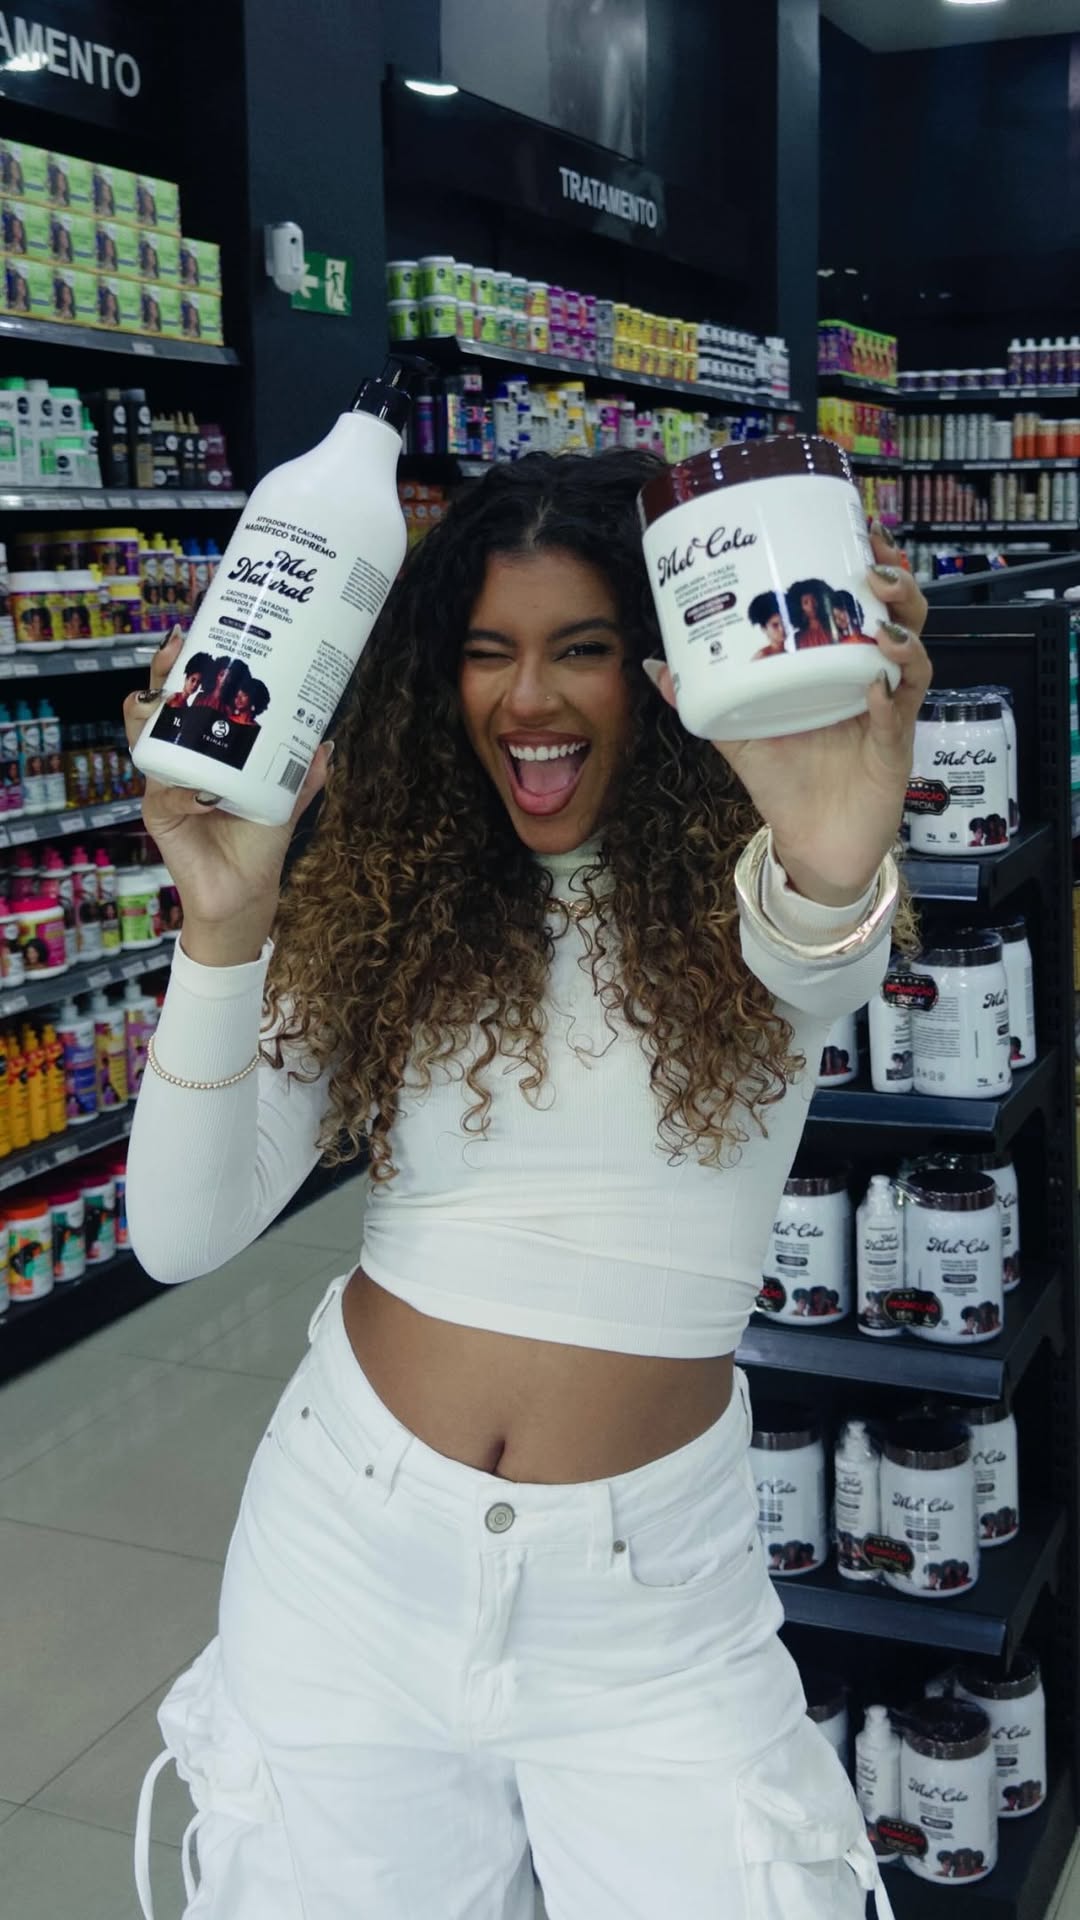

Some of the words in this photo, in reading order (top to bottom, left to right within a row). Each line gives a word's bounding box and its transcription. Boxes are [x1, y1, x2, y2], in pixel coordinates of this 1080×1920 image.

[559, 166, 657, 228] TRATAMENTO
[244, 523, 289, 539] MAGNÍFICO
[289, 534, 337, 559] SUPREMO
[286, 523, 297, 532] DE
[297, 527, 328, 544] CACHOS
[274, 550, 317, 582] Mel
[657, 546, 695, 588] Mel
[694, 526, 757, 558] Cola
[228, 557, 314, 603] Natural
[237, 607, 264, 619] INTESO
[269, 610, 294, 624] BRILHO
[232, 639, 262, 654] NTURAIS
[933, 750, 967, 766] Mel
[968, 749, 997, 766] Cola
[926, 1237, 960, 1254] Mel
